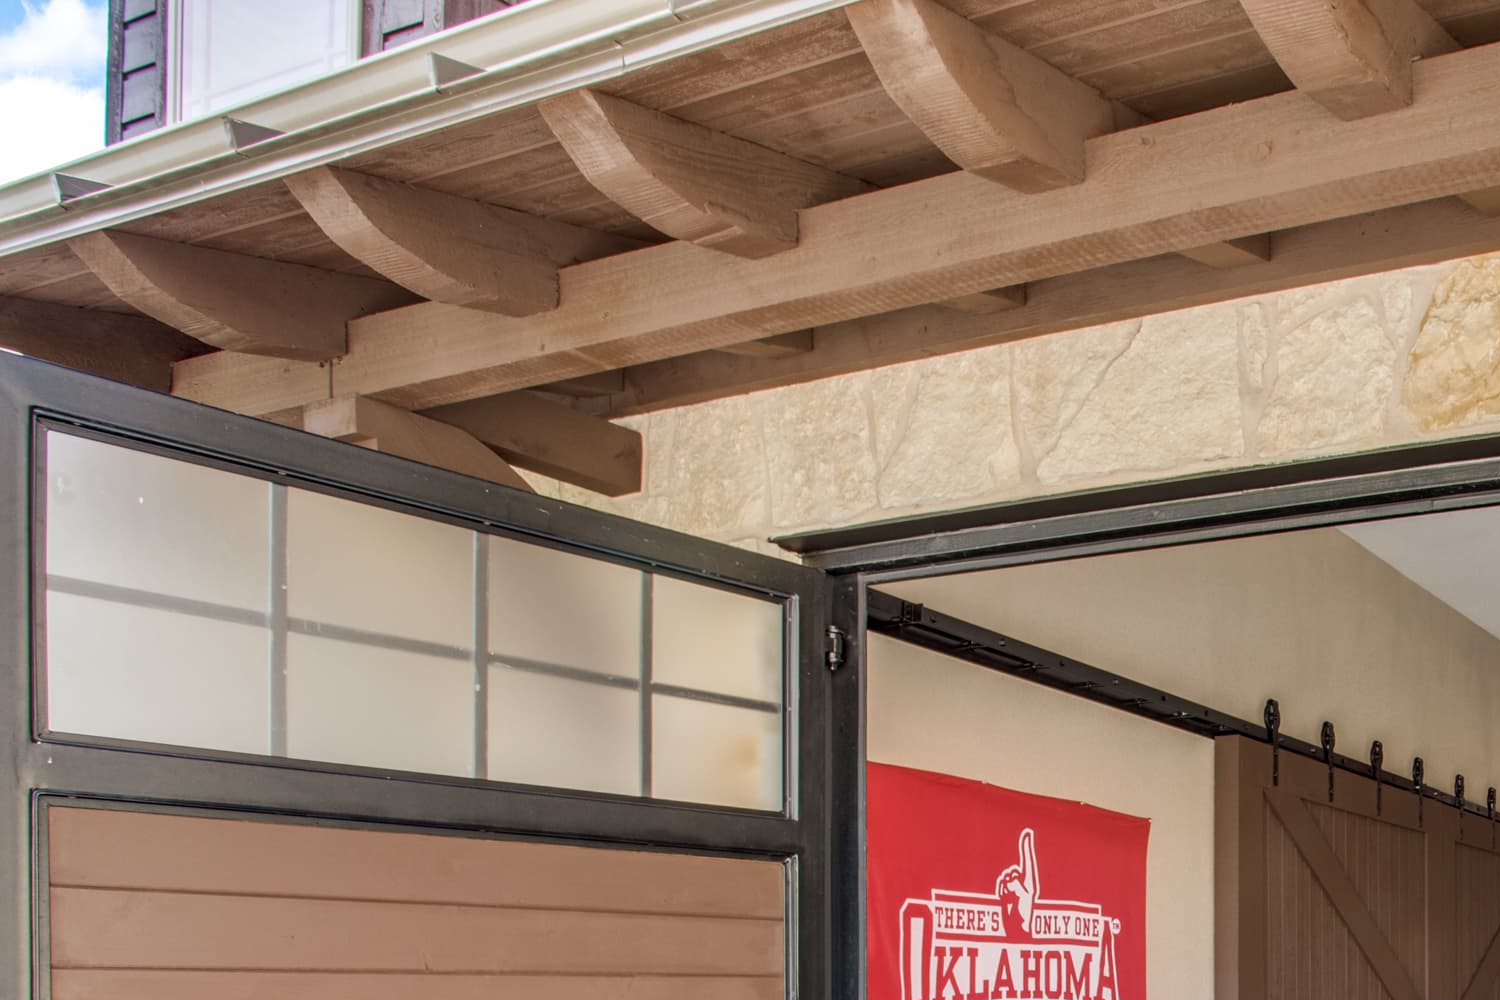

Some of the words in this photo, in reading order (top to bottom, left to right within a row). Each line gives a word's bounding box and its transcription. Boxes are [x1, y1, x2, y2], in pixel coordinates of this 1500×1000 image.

[934, 906, 1000, 932] THERE'S
[1034, 914, 1071, 936] ONLY
[1074, 916, 1100, 938] ONE
